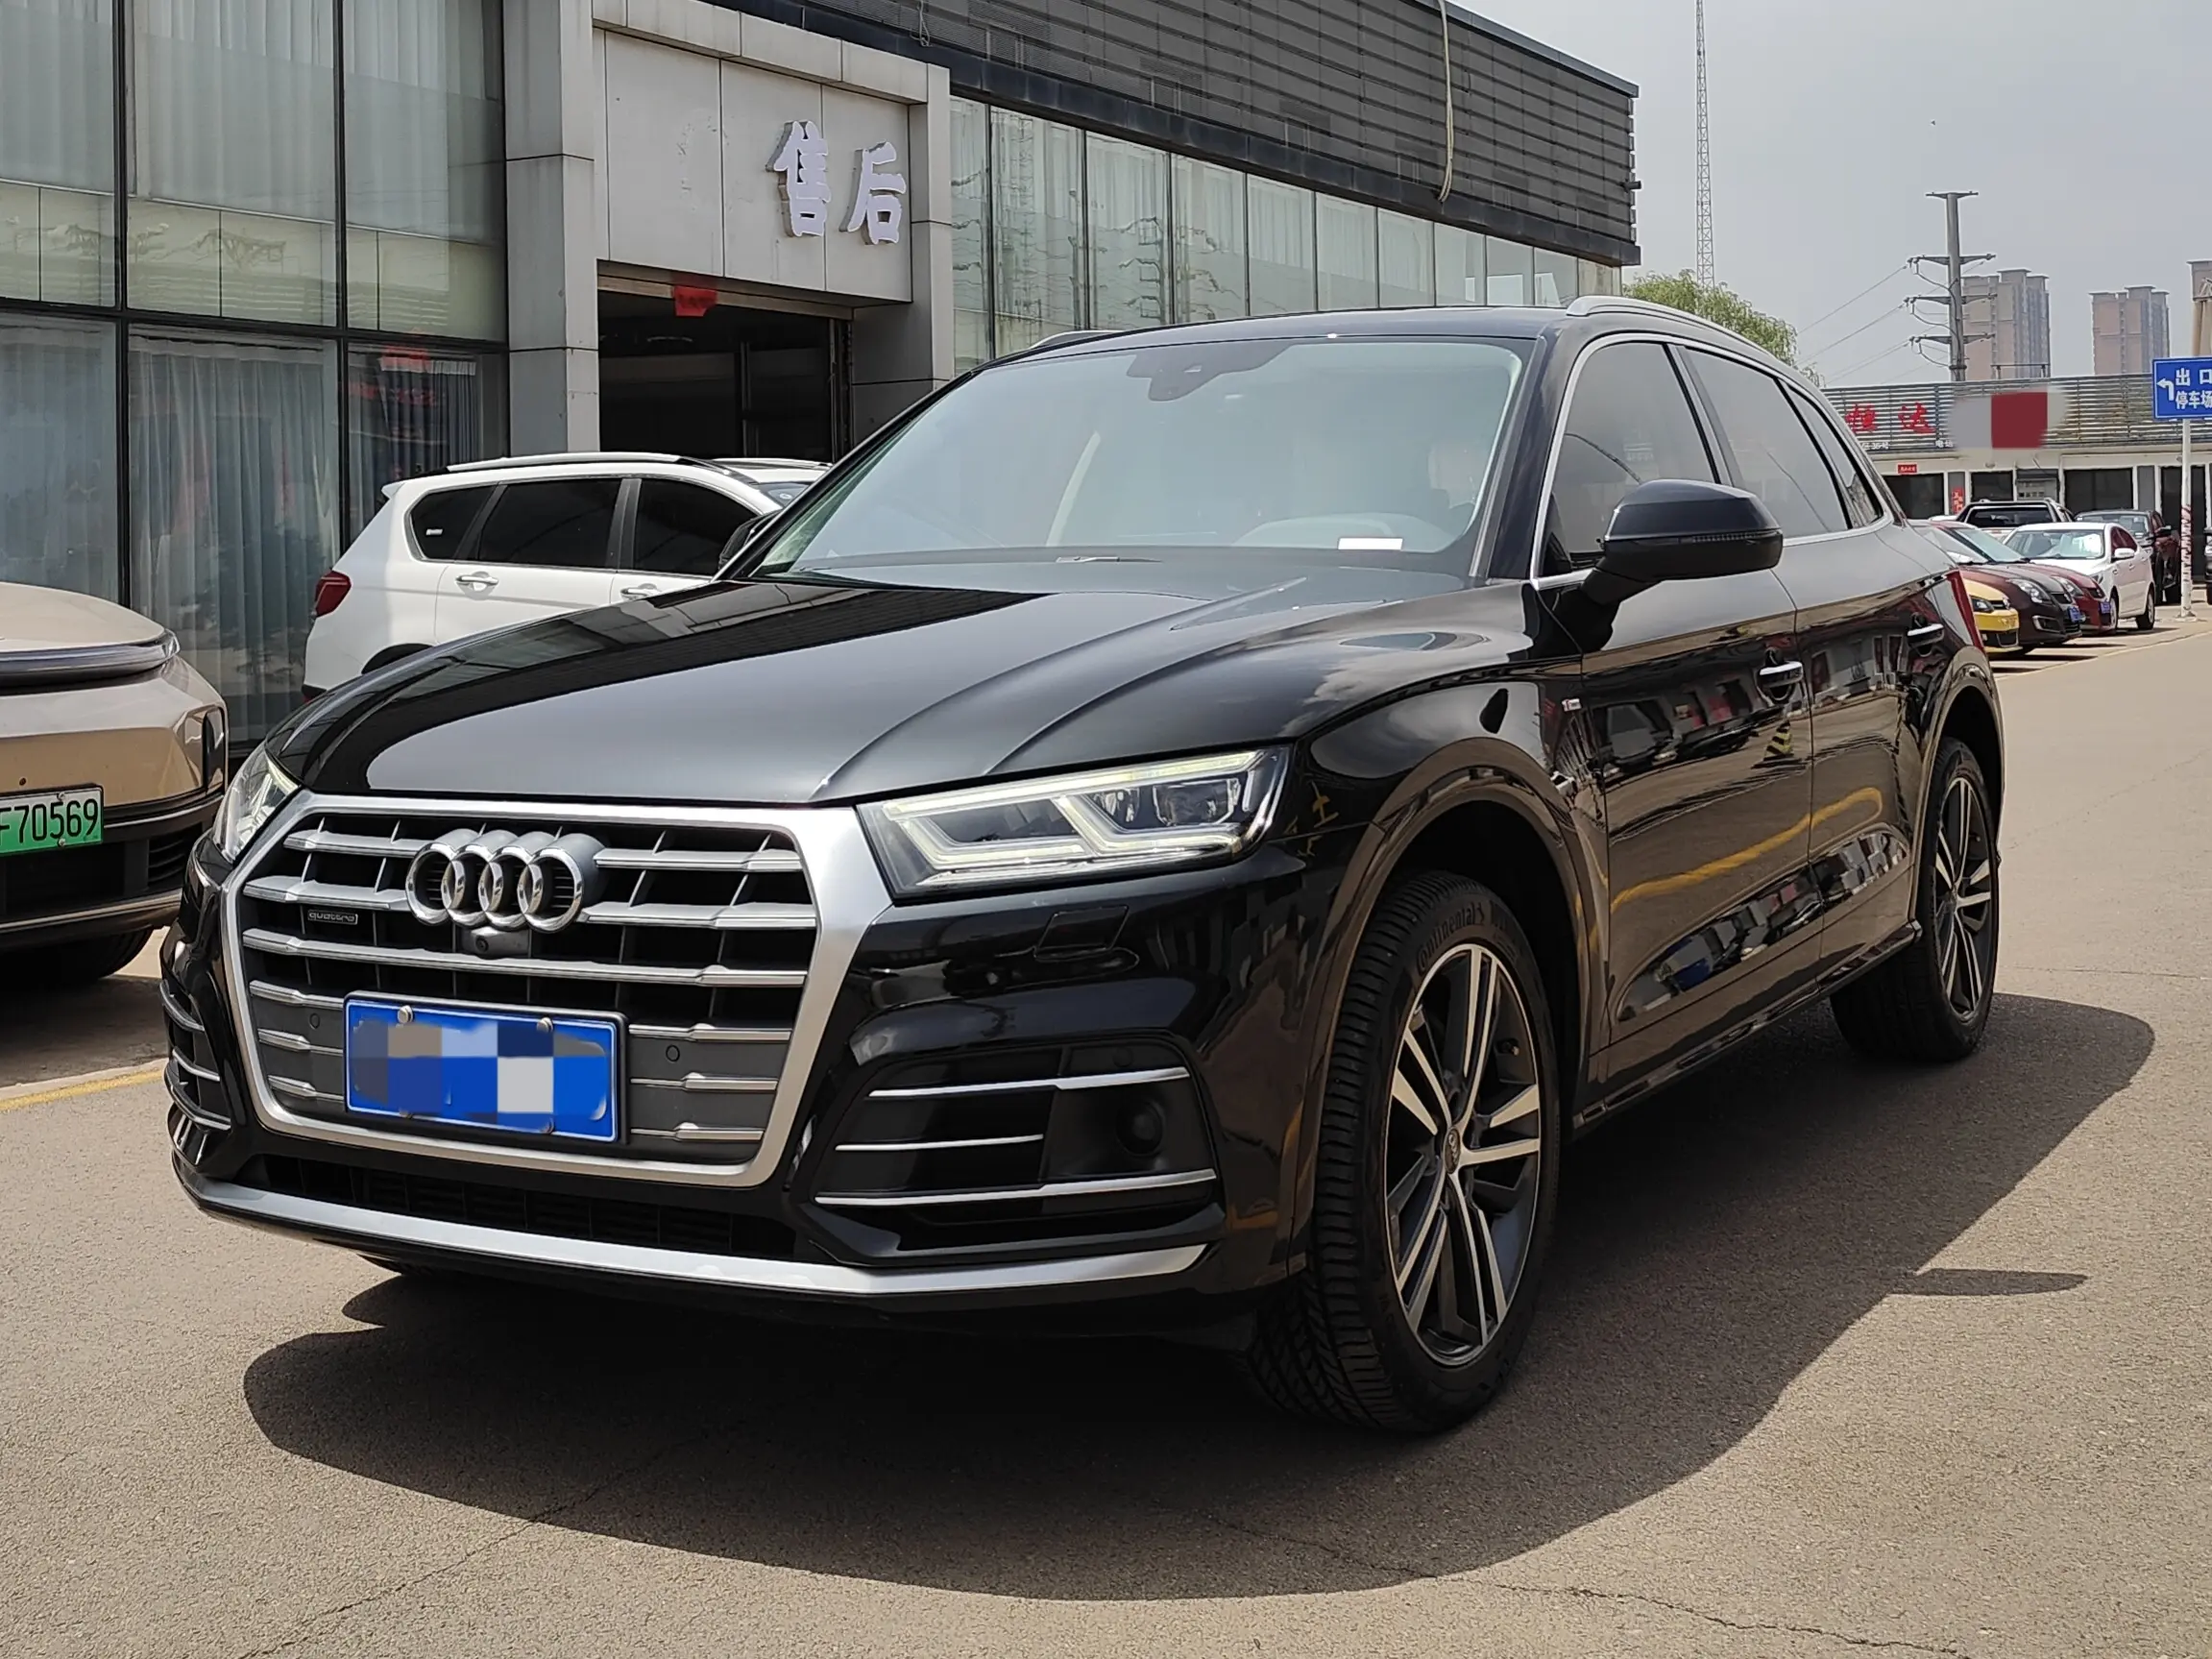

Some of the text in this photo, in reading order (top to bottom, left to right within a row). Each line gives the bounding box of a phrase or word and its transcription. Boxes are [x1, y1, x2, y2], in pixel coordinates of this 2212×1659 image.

[766, 120, 907, 245] 售后
[2176, 367, 2212, 386] 出口
[2176, 389, 2212, 409] 停车场
[308, 912, 355, 923] quattro
